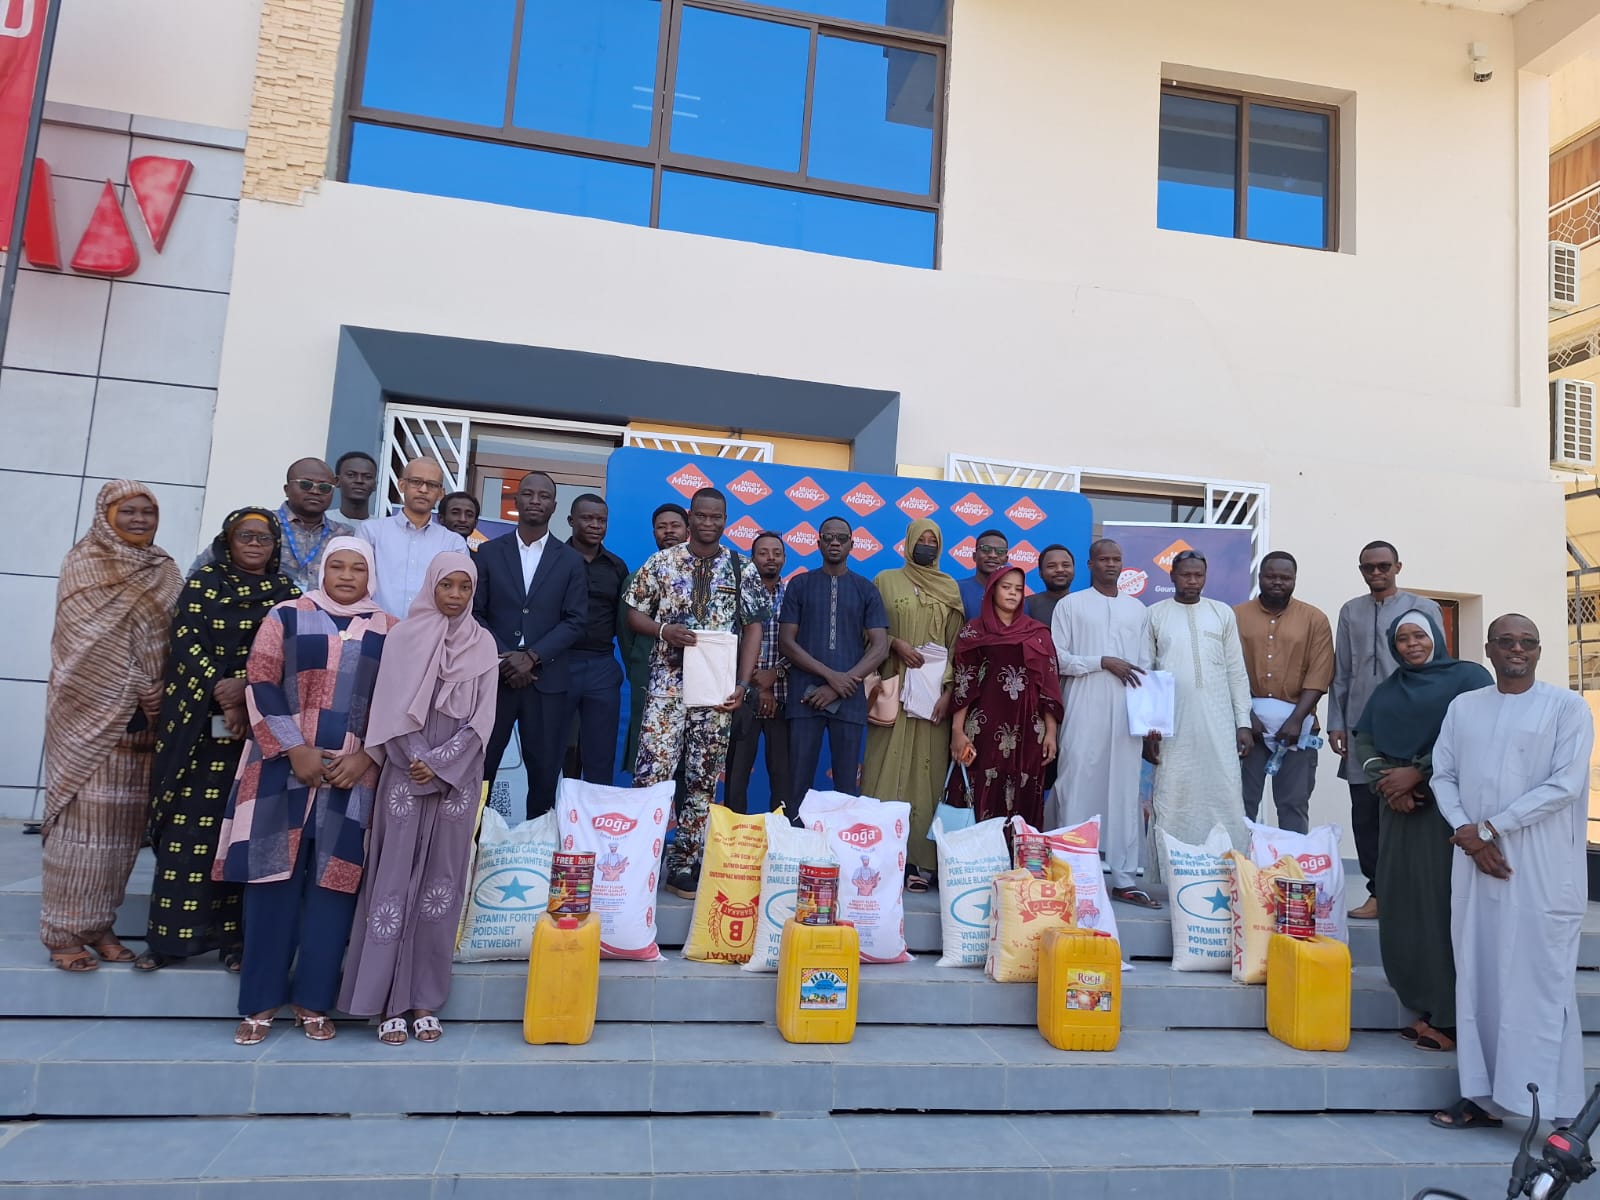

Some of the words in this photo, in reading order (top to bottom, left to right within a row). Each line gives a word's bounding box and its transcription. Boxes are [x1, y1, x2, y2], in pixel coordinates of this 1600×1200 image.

[672, 476, 704, 488] Money
[732, 484, 762, 495] Money
[790, 490, 820, 501] Money
[846, 496, 876, 507] Money
[900, 501, 929, 511] Money
[955, 506, 984, 516] Money
[1009, 510, 1037, 520] Money
[787, 535, 817, 546] Money
[852, 541, 874, 551] oney
[953, 549, 973, 558] Mon
[1009, 553, 1036, 563] Money
[475, 913, 507, 923] VITAMIN
[510, 913, 538, 922] FORTIF
[729, 921, 743, 941] B
[1187, 924, 1220, 934] VITAMIN
[1189, 947, 1204, 956] NET
[1207, 950, 1232, 958] WEIGH
